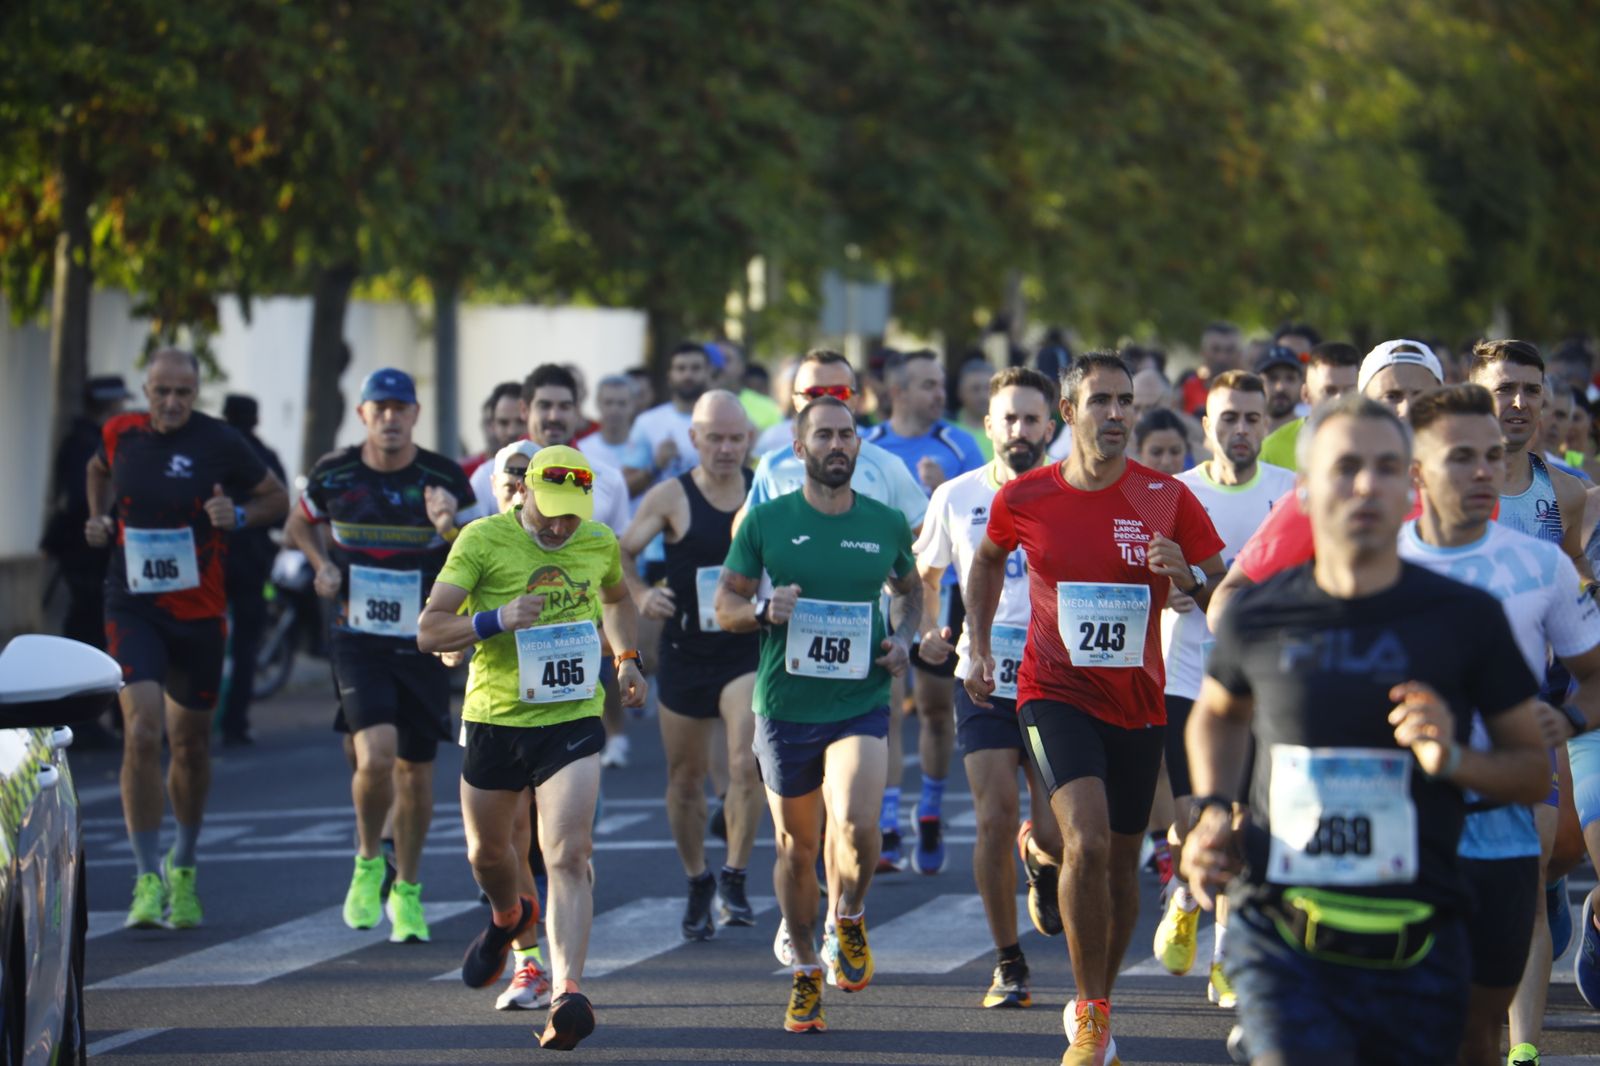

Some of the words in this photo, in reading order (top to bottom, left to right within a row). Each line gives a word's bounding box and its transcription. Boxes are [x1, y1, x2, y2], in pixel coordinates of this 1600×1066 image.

[1114, 519, 1143, 527] TIRADA
[142, 559, 179, 580] 405
[1062, 599, 1094, 609] MEDIA
[793, 613, 824, 625] MEDIA
[1079, 621, 1126, 652] 243
[521, 641, 552, 651] MEDIA
[807, 635, 851, 664] 458
[542, 658, 585, 688] 465
